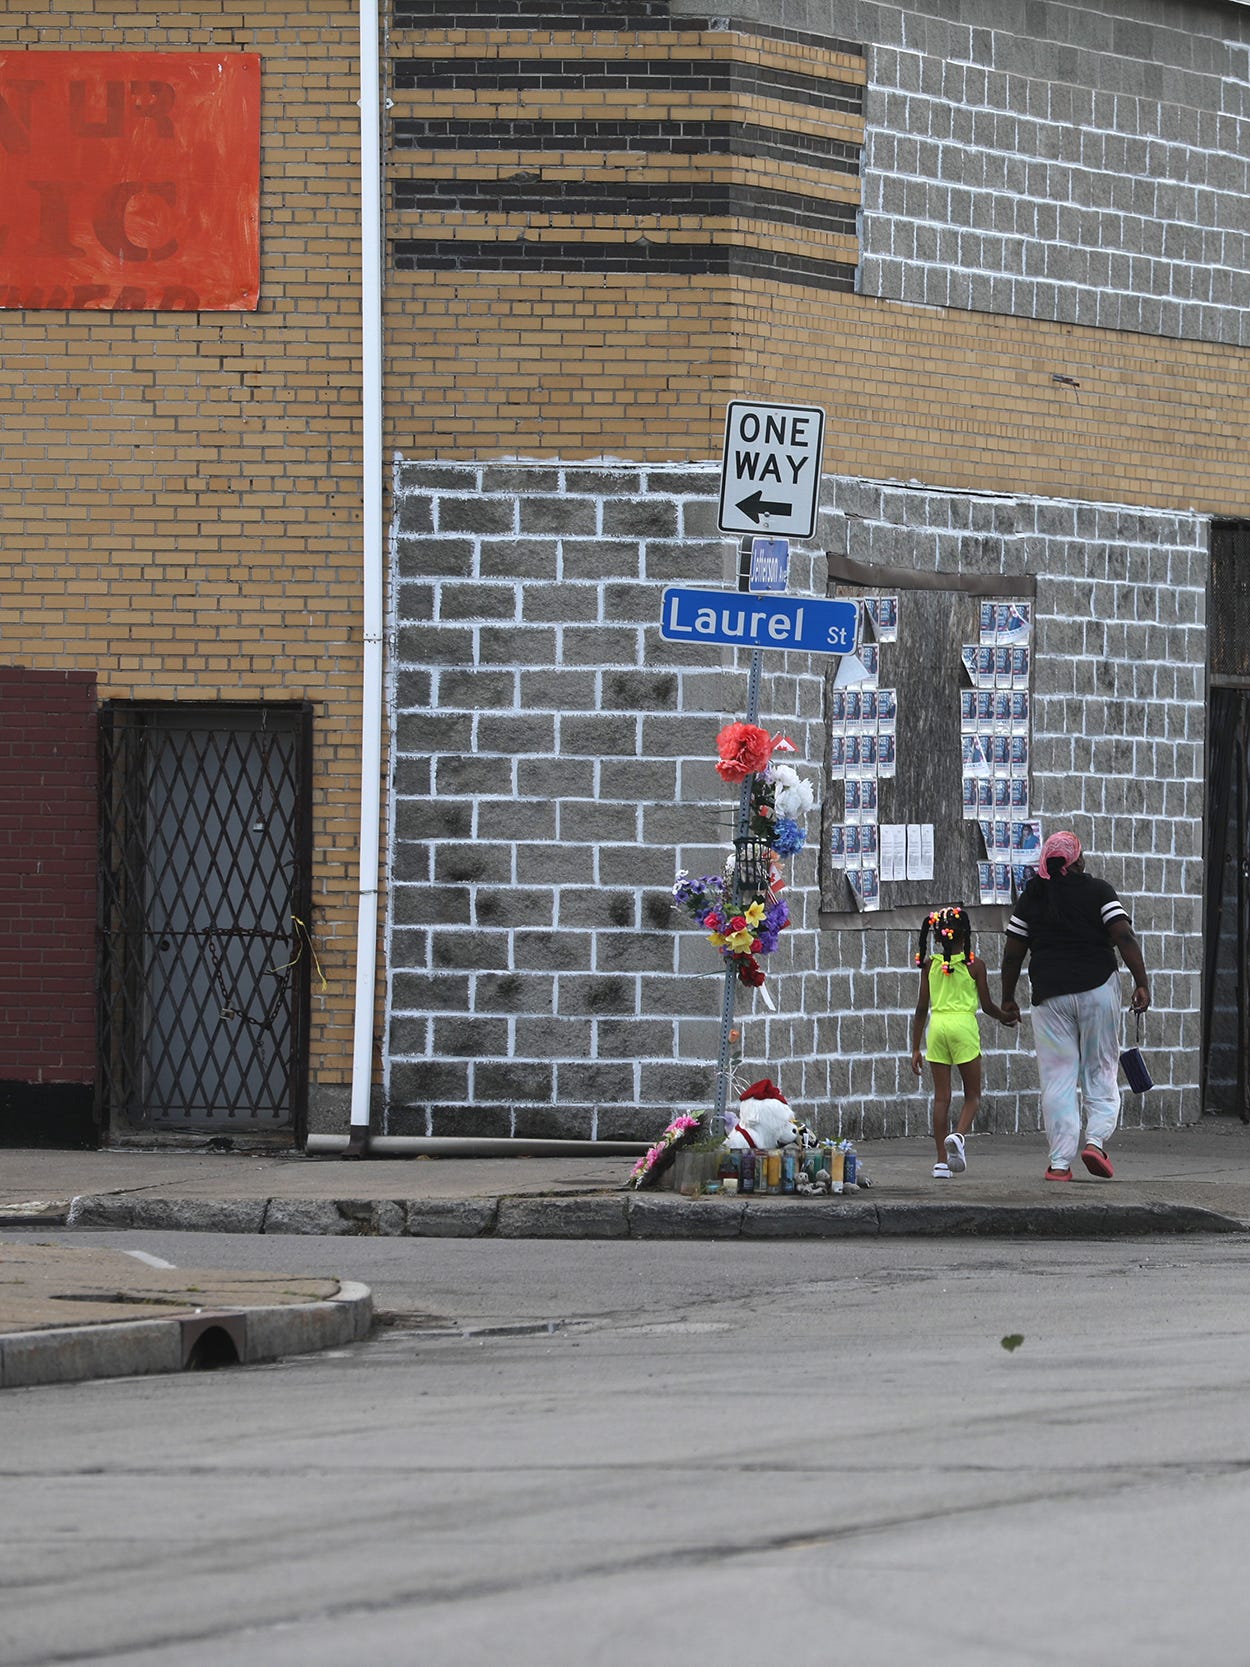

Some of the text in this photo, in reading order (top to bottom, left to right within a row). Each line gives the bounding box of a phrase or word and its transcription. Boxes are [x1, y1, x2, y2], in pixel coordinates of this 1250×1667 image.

[739, 413, 810, 447] ONE
[735, 450, 809, 484] WAY
[669, 597, 847, 645] Laurel St
